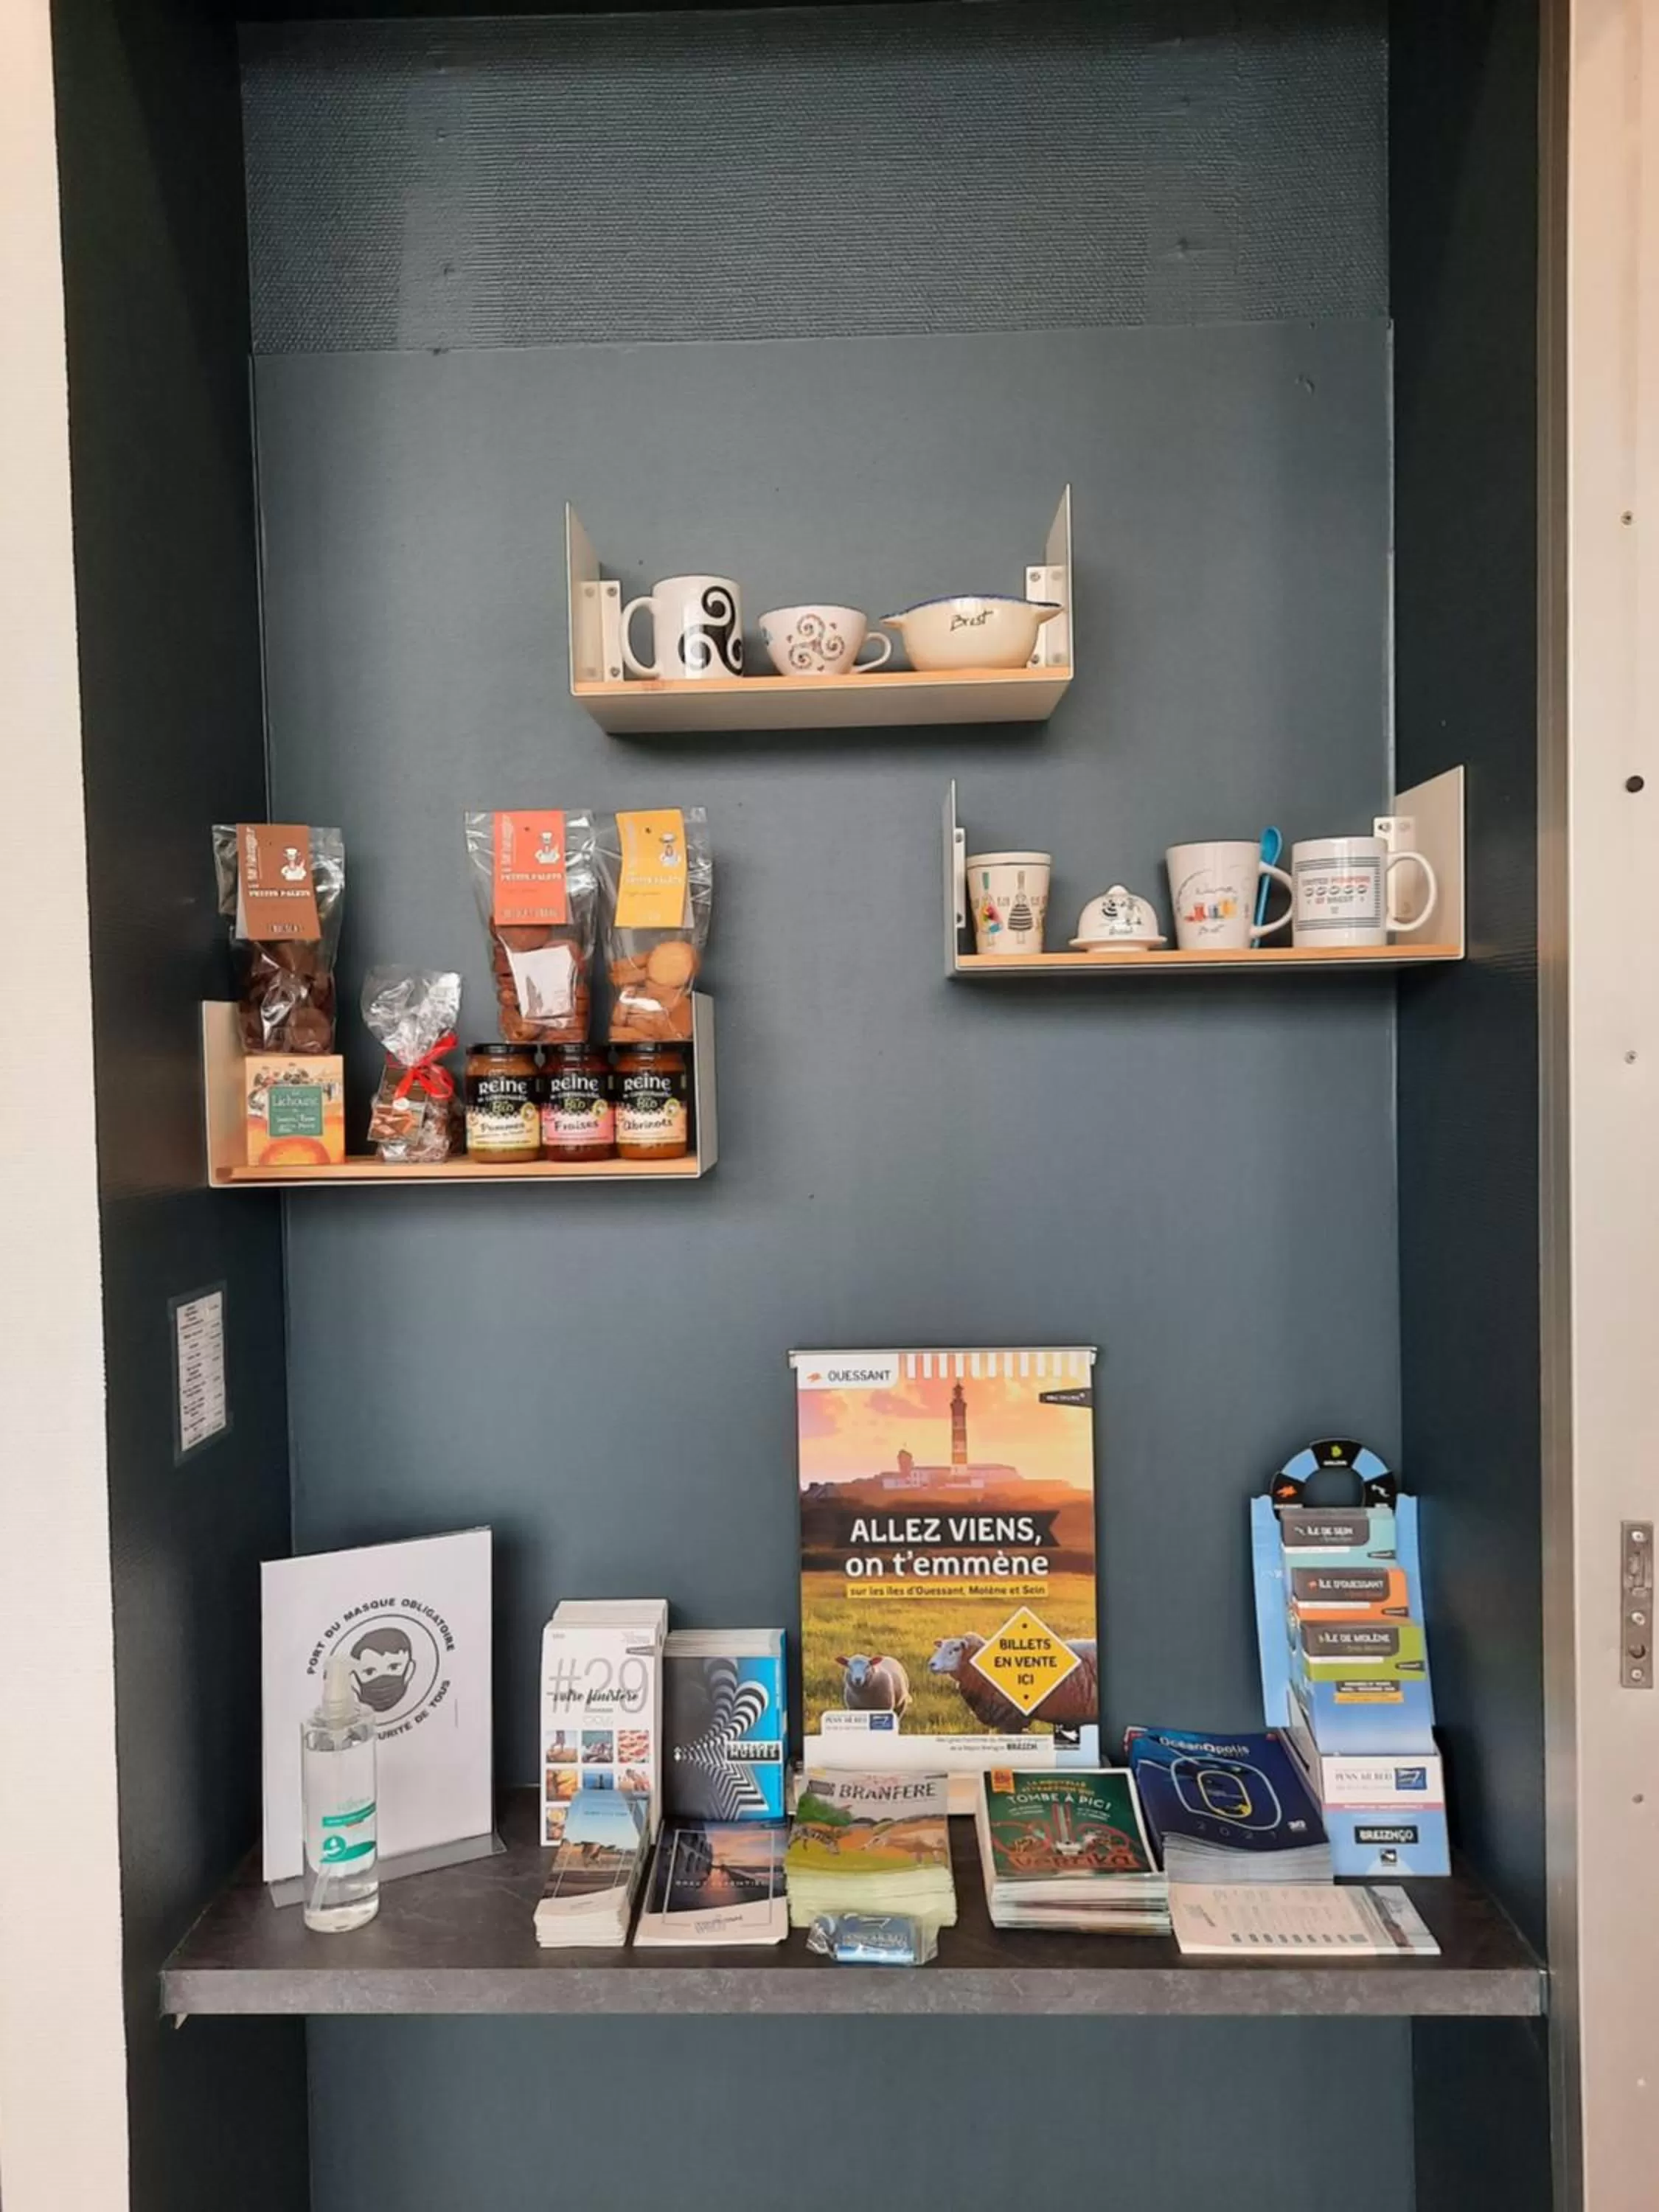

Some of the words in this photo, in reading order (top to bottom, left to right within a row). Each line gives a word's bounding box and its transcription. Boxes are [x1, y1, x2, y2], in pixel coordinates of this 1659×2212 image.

[950, 608, 994, 632] Brest
[554, 1120, 598, 1130] Fraises
[828, 1370, 891, 1382] OUESSANT
[850, 1518, 941, 1543] ALLEZ
[949, 1517, 1042, 1545] VIENS,
[846, 1557, 883, 1576] on
[893, 1551, 1048, 1576] t'emmène
[869, 1586, 884, 1596] les
[969, 1586, 1006, 1595] Molène
[1009, 1587, 1020, 1595] et
[1023, 1586, 1046, 1595] Sein
[307, 1641, 324, 1674] PORT
[324, 1621, 341, 1638] DU
[344, 1598, 395, 1621] MASQUE
[401, 1599, 455, 1652] OBLIGATOIRE
[1000, 1638, 1051, 1650] BILLETS
[994, 1656, 1012, 1668] EN
[1015, 1656, 1057, 1668] VENTE
[1018, 1673, 1034, 1685] ICI
[546, 1658, 648, 1714] #29
[414, 1711, 429, 1724] DE
[428, 1680, 451, 1708] TOUS
[1006, 1793, 1059, 1804] TOMBE
